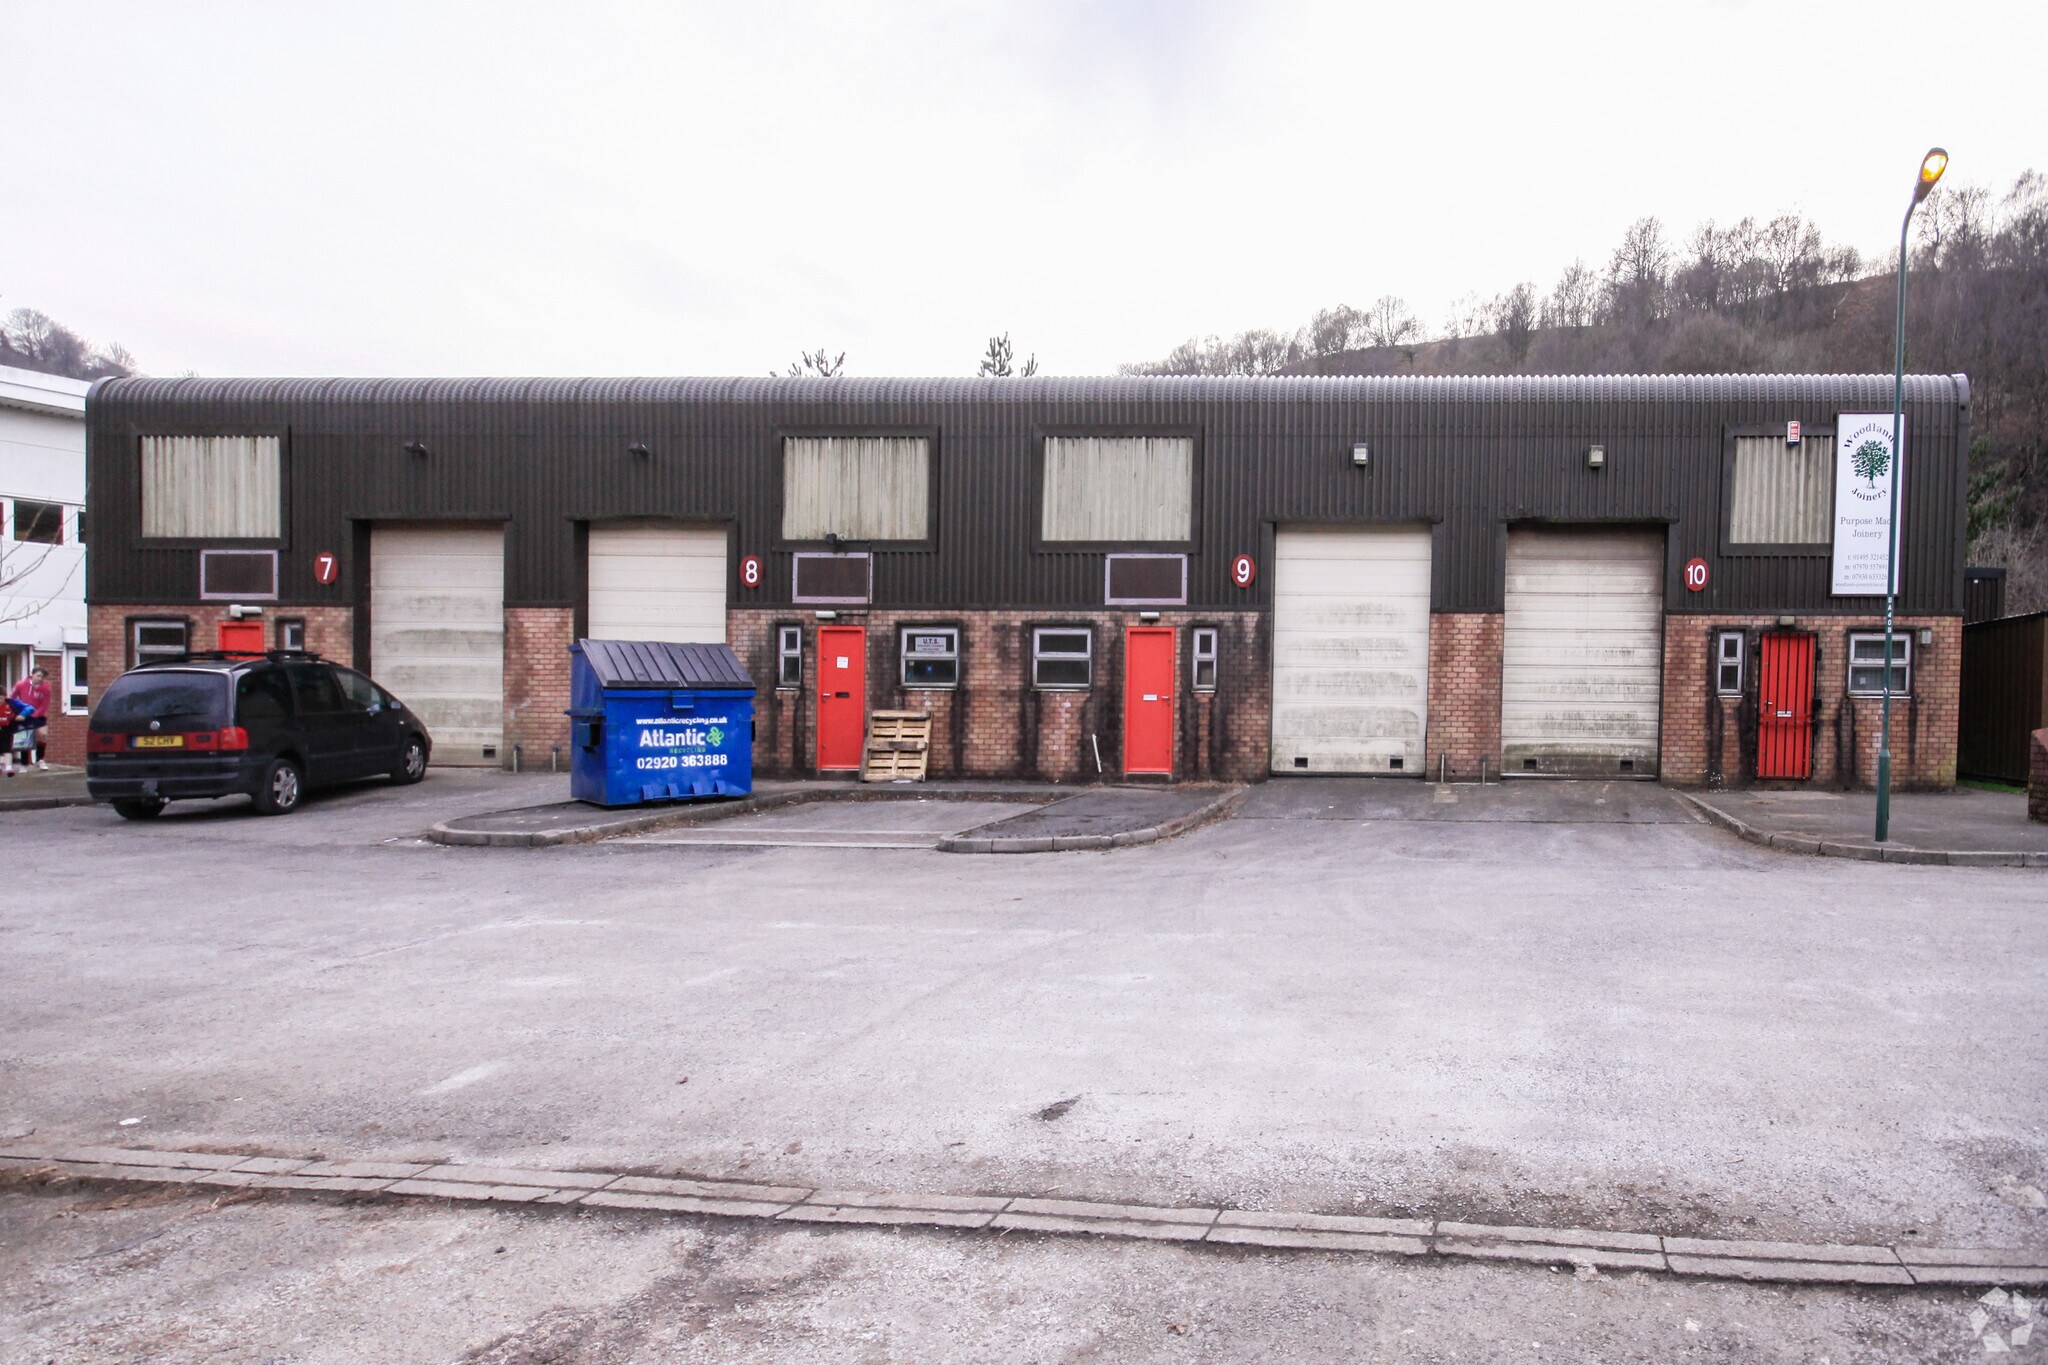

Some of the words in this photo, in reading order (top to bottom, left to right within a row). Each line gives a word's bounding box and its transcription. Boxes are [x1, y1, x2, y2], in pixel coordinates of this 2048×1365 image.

[1851, 487, 1887, 502] Joinery
[1840, 516, 1873, 527] Purpose
[1852, 529, 1883, 540] Joinery
[1852, 553, 1869, 561] 01495
[320, 557, 332, 580] 7
[745, 561, 758, 583] 8
[1237, 559, 1250, 582] 9
[1687, 565, 1706, 585] 10
[636, 716, 728, 725] www.atlanticrecycling.co.uk
[639, 728, 706, 747] Atlantic
[636, 756, 678, 770] 02920
[681, 754, 728, 768] 363888
